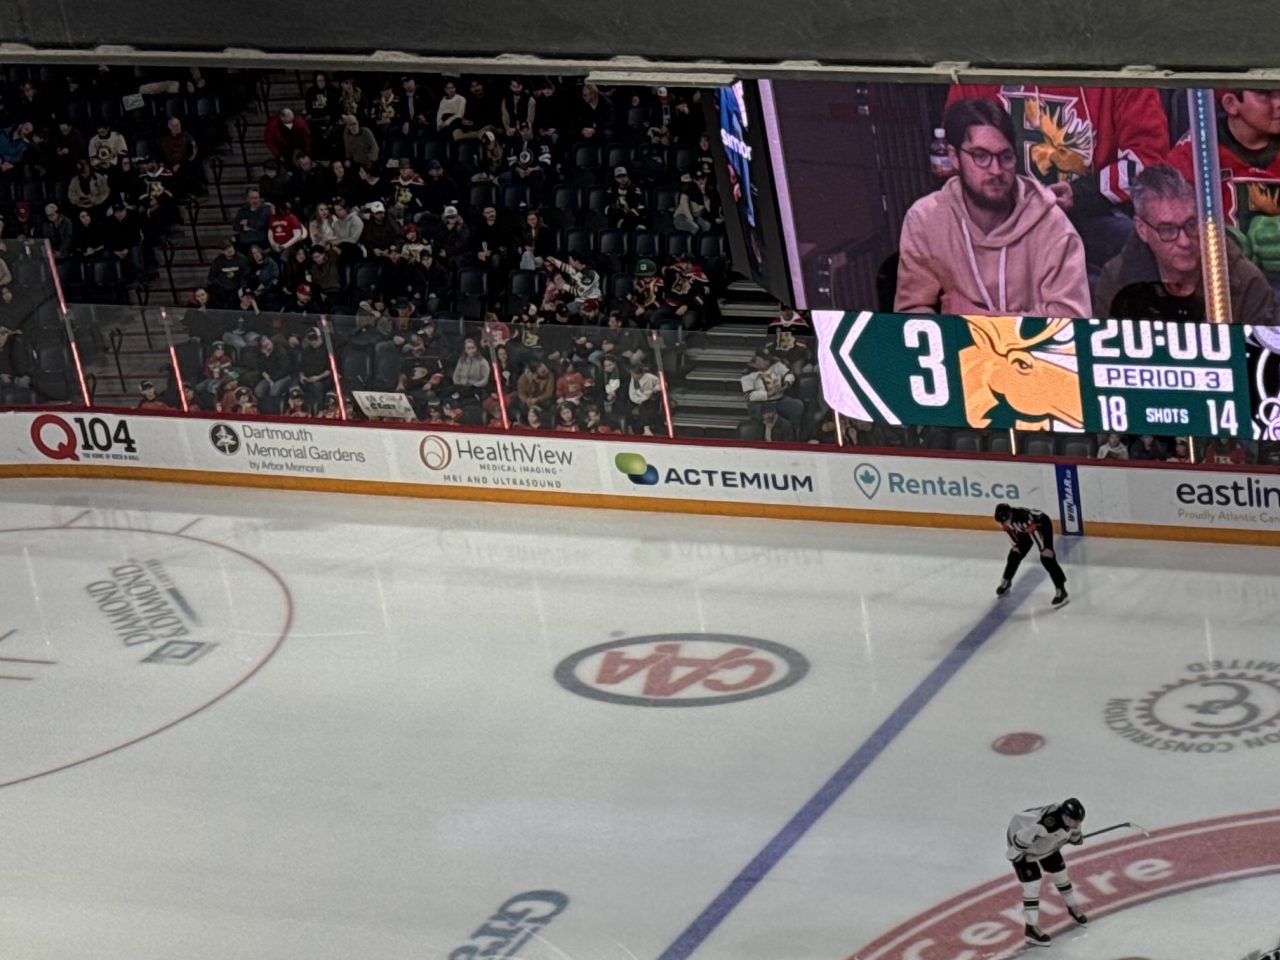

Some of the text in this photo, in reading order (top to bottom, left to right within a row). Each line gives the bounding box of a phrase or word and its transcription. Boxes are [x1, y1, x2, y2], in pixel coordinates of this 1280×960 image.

[1088, 319, 1232, 361] 20:00
[903, 319, 950, 407] 3
[1106, 367, 1221, 389] PERIOD 3
[1097, 395, 1239, 436] 18 SHOTS 14
[242, 424, 313, 442] Dartmouth
[246, 443, 366, 463] Memorial Gardens
[456, 439, 573, 466] HealthView
[250, 460, 325, 473] by Arbor Memorial
[479, 463, 557, 475] MEDICAL IMAGING
[443, 474, 562, 488] MRI AND ULTRASOUND
[665, 467, 813, 493] ACTEMIUM
[888, 472, 1020, 500] Rentals.ca
[1061, 469, 1076, 523] WINMAR.ca
[1178, 508, 1215, 523] Proudly
[1218, 510, 1256, 523] Atlantic
[595, 643, 775, 698] CAA
[1103, 698, 1235, 754] CONSTRUCTION
